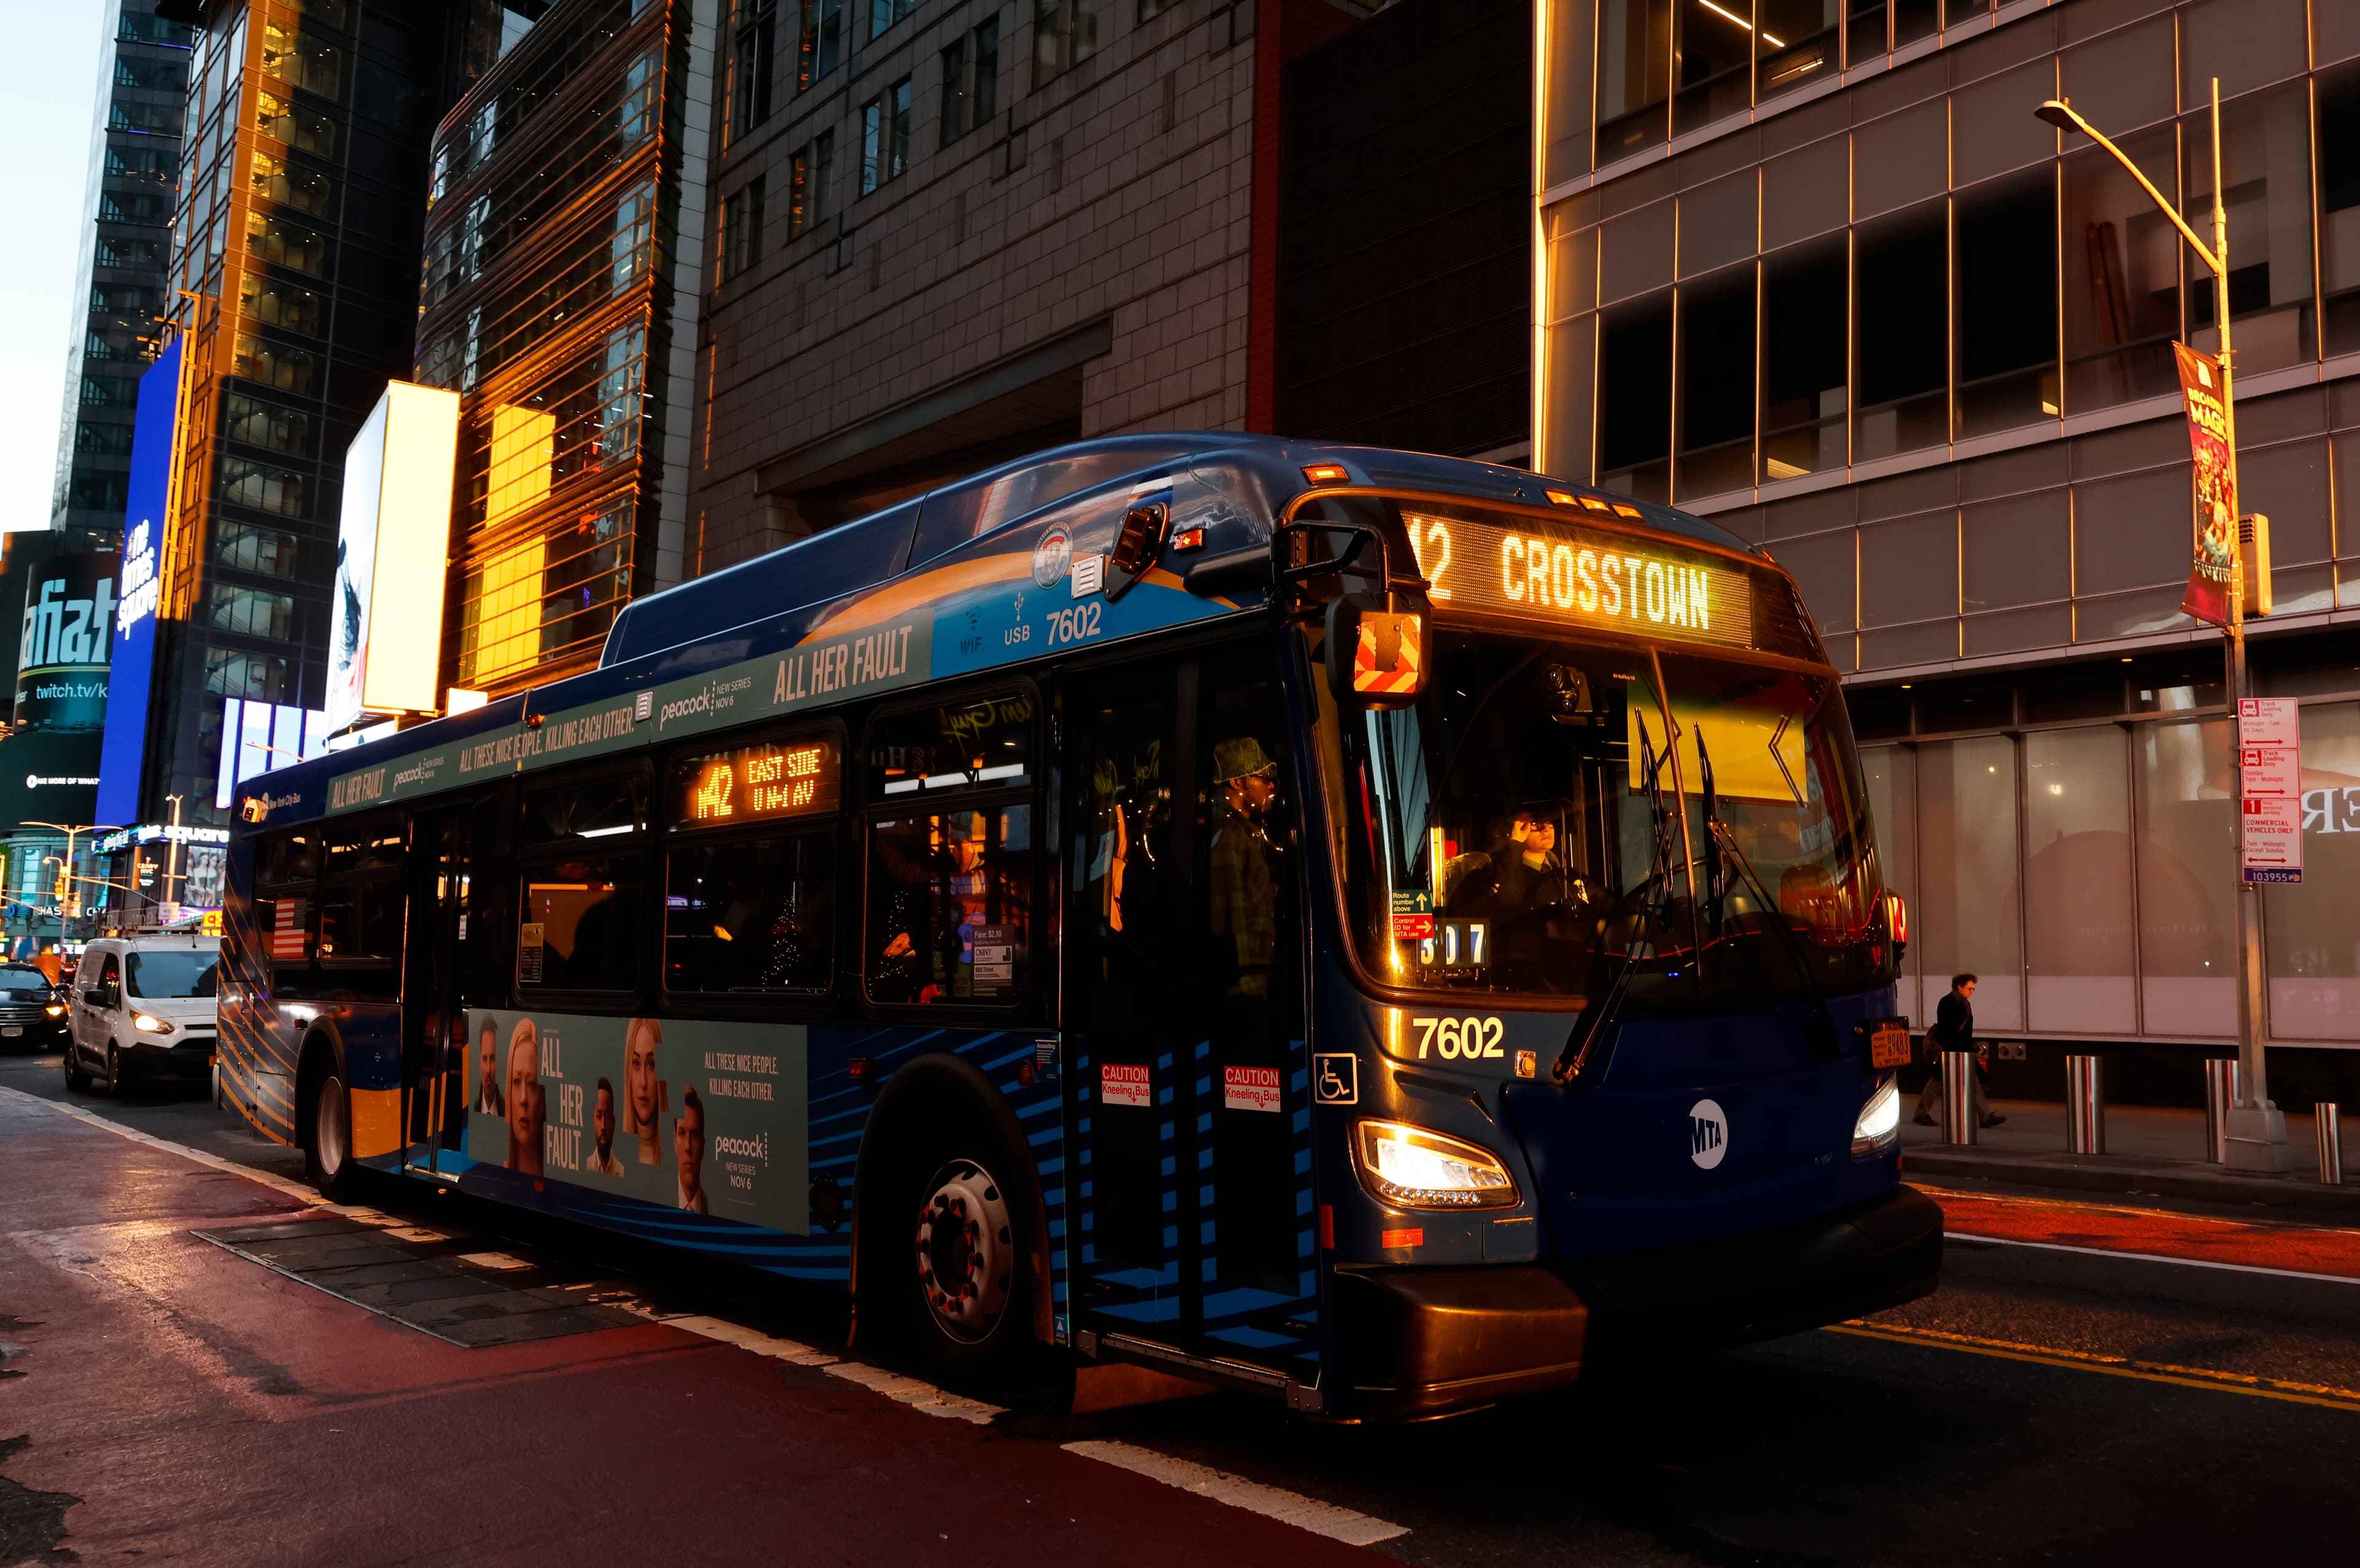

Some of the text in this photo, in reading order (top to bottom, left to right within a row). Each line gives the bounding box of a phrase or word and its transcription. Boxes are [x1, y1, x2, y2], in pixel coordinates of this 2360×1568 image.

[2187, 387, 2224, 418] BROAD
[2190, 401, 2227, 440] MAGIC
[1503, 536, 1709, 630] CROSSTOWN
[1004, 625, 1030, 645] USB
[1047, 602, 1101, 646] 7602
[773, 624, 913, 704] ALL HER FAULT
[36, 683, 108, 699] twitch.tv/k
[717, 677, 752, 696] NEW SERIES
[659, 686, 709, 731] peacock
[715, 696, 734, 710] NOV 6
[459, 748, 471, 773] ALL
[473, 742, 495, 770] THESE
[495, 737, 513, 764] NICE
[545, 722, 577, 752] KILLING
[578, 715, 602, 745] EACH
[603, 706, 634, 739] OTHER.
[393, 762, 422, 793] peacock
[749, 756, 783, 783] EAST
[787, 749, 820, 777] SIDE
[332, 768, 386, 809] ALL HER FAULT
[698, 766, 733, 819] M42
[793, 780, 814, 806] AV
[2250, 801, 2255, 812] 1
[165, 825, 229, 844] square
[2254, 872, 2287, 882] 103955
[975, 929, 1002, 939] Fare: $2.90
[1412, 1017, 1504, 1060] 7602
[1892, 1033, 1908, 1056] 9483
[541, 1037, 563, 1078] ALL
[705, 1052, 779, 1075] ALL THESE NICE PEOPLE.
[1103, 1066, 1149, 1081] CAUTION
[1225, 1068, 1278, 1086] CAUTION
[709, 1078, 774, 1101] KILLING EACH OTHER.
[1103, 1084, 1149, 1097] Kneeling Bus
[1225, 1087, 1280, 1102] Kneeling Bus
[560, 1083, 583, 1127] HER
[546, 1125, 581, 1172] FAULT
[715, 1134, 763, 1161] peacock
[1690, 1116, 1722, 1155] MTA
[726, 1163, 755, 1175] NEW SERIES
[730, 1176, 752, 1190] NOV 6
